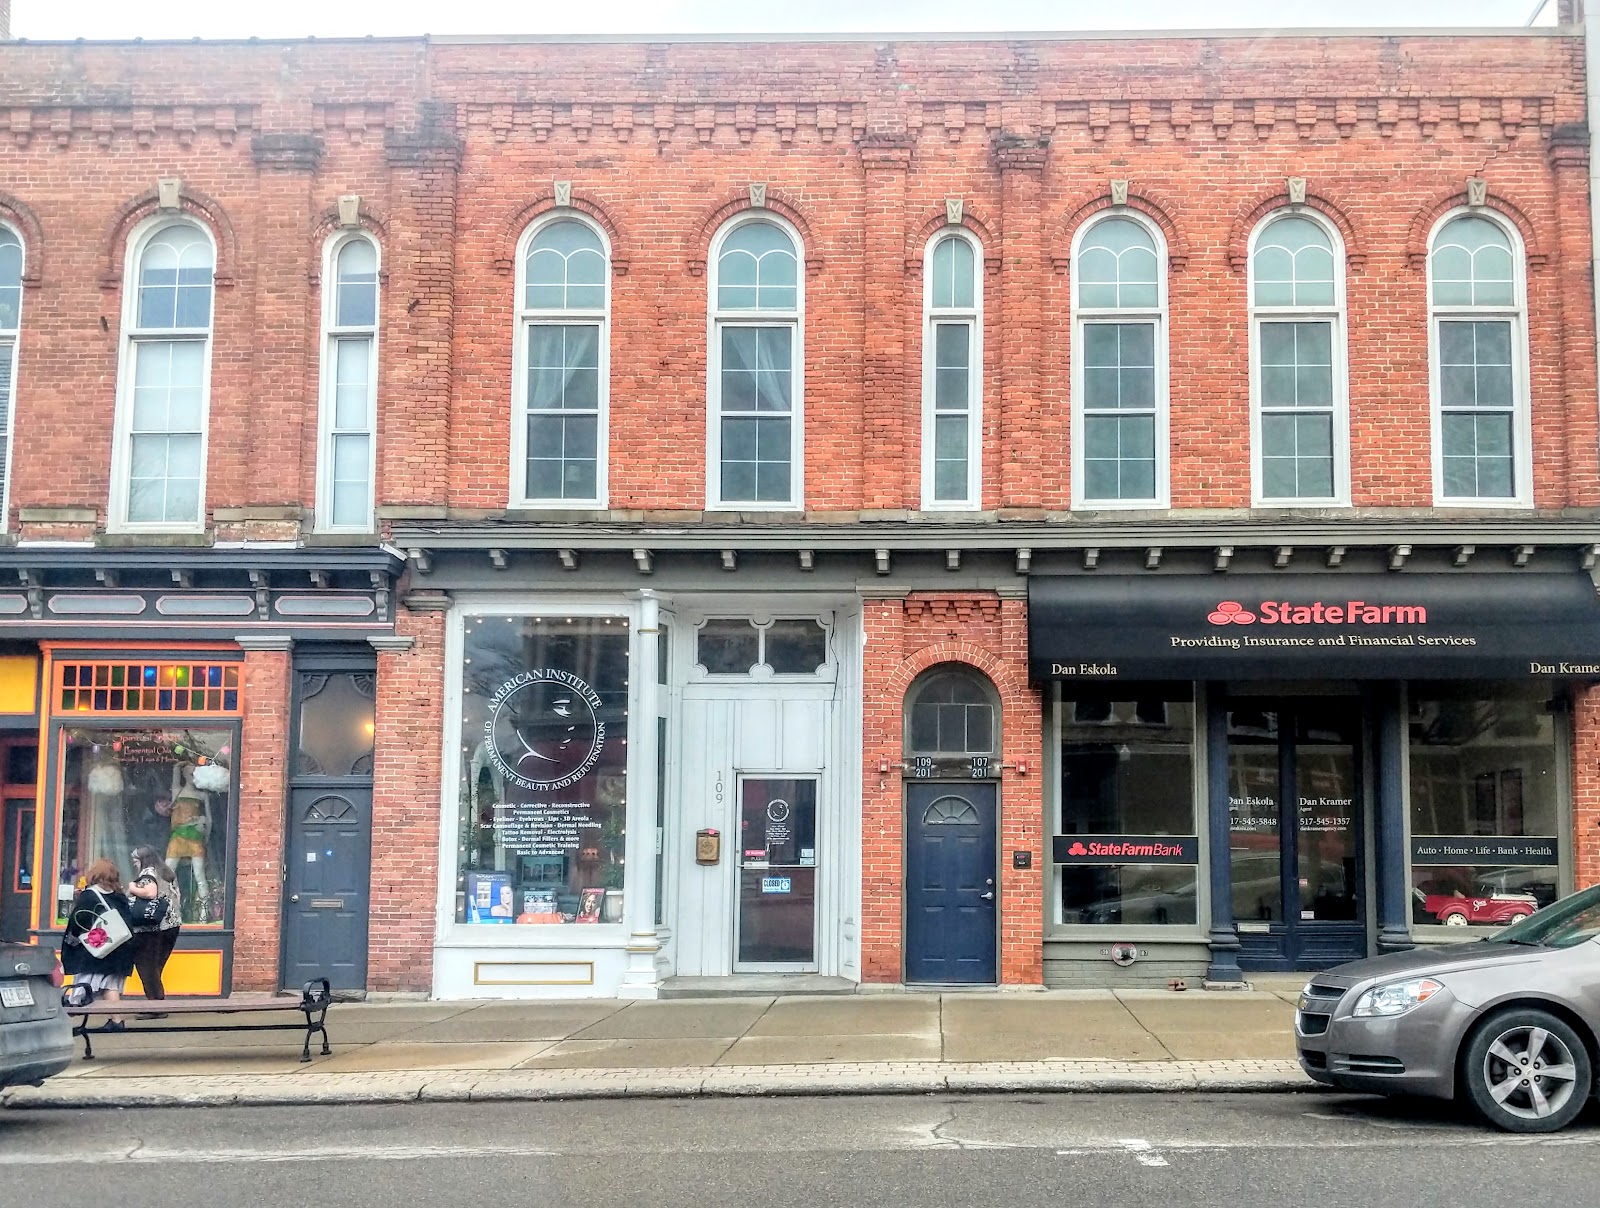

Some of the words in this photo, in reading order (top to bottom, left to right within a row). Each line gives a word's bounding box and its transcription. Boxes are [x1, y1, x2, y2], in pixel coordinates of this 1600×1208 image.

[1170, 636, 1240, 650] Providing
[1243, 636, 1314, 647] Insurance
[1318, 635, 1346, 646] and
[1348, 635, 1415, 646] Financial
[1417, 635, 1477, 646] Services
[1051, 663, 1076, 675] Dan
[1079, 663, 1117, 675] Eskola
[1530, 662, 1556, 673] Dan
[1558, 662, 1600, 673] Krame
[487, 668, 543, 713] AMERICAN
[546, 668, 603, 709] INSTITUTE
[484, 720, 492, 734] OF
[571, 722, 605, 782] REJUVENATION
[484, 735, 516, 782] PERMANENT
[916, 757, 932, 767] 109
[972, 757, 988, 767] 107
[916, 768, 931, 777] 201
[972, 768, 987, 777] 201
[515, 777, 550, 791] BEAUTY
[551, 779, 571, 791] AND
[715, 770, 723, 804] 109
[1246, 796, 1274, 806] Eskola
[1300, 797, 1318, 806] Dan
[1319, 797, 1352, 806] Kramer
[1230, 817, 1277, 826] 17-545-5848
[1300, 817, 1351, 826] 517-545-1357
[1417, 846, 1437, 855] Auto
[1443, 846, 1468, 855] Home
[1475, 846, 1490, 855] Life
[1497, 846, 1518, 855] Bank
[1525, 847, 1552, 855] Health
